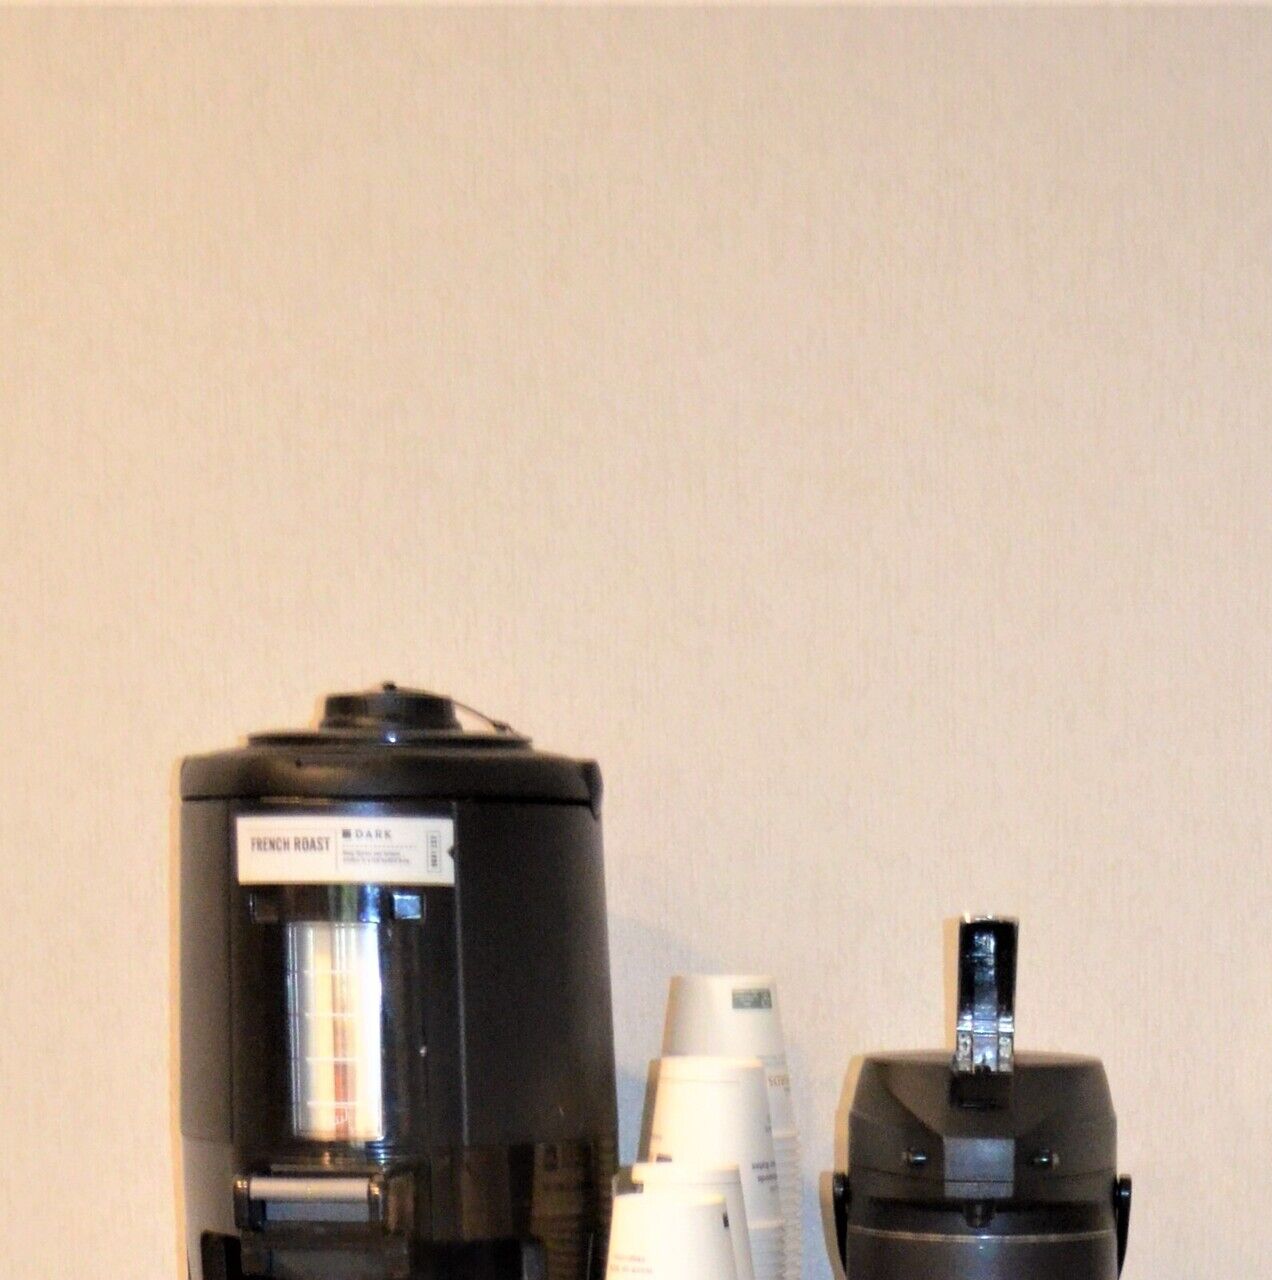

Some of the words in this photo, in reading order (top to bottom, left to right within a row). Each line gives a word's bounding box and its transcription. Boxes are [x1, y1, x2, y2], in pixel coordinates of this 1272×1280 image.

[355, 828, 392, 839] DARK
[250, 836, 290, 851] FRENCH
[293, 836, 331, 851] ROAST
